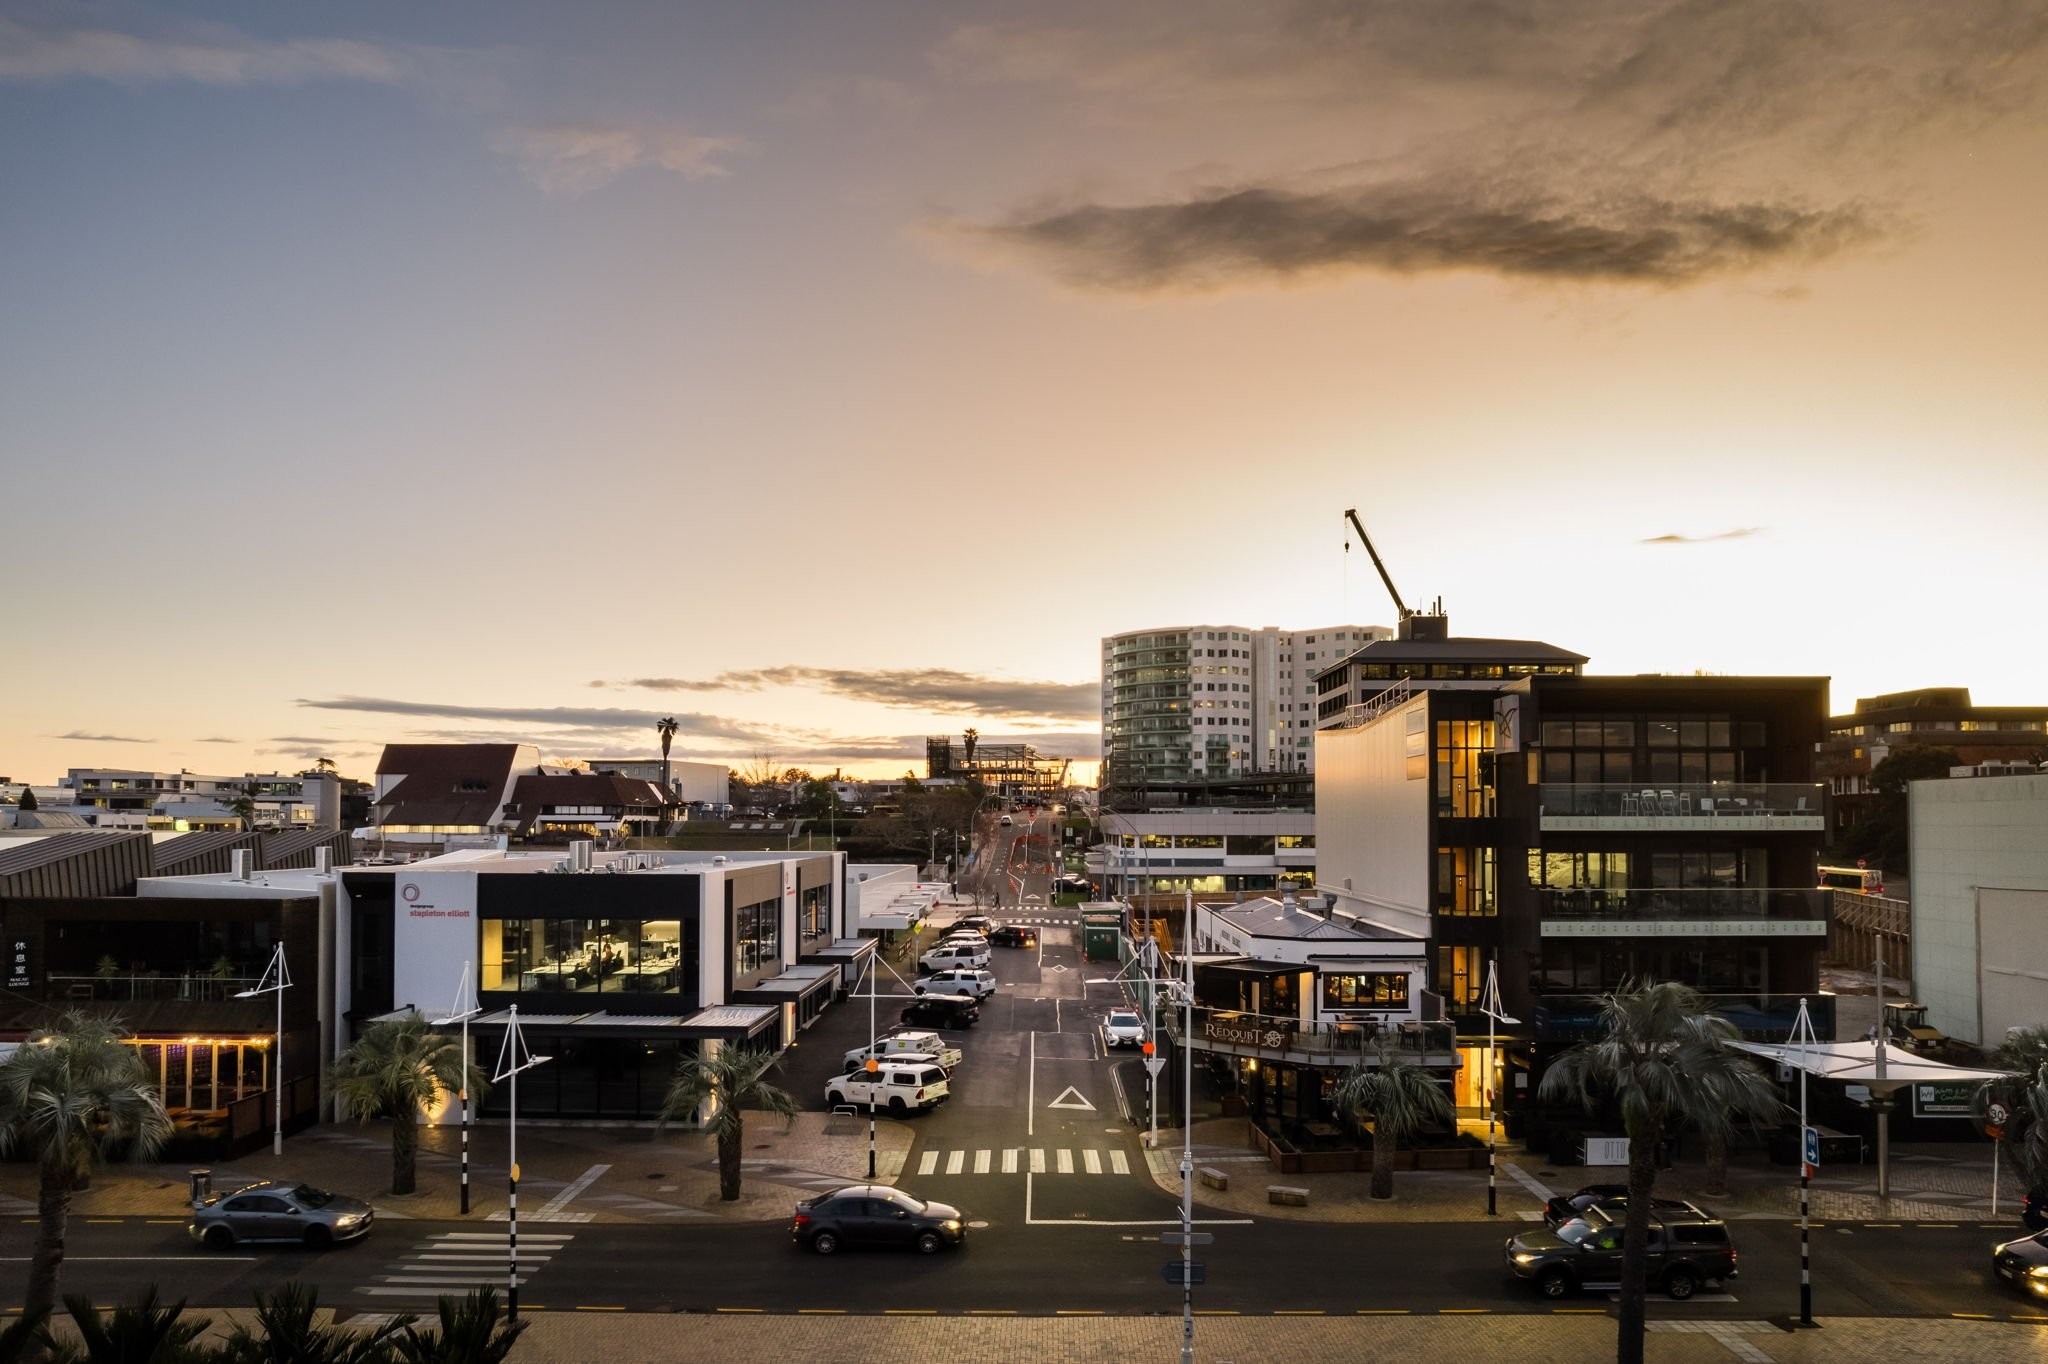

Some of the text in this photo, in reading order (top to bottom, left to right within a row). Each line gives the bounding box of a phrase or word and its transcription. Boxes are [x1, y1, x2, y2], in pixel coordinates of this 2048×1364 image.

[409, 909, 470, 918] stapleton elliott
[1991, 1108, 2003, 1120] 30
[1604, 1141, 1626, 1160] OTTO
